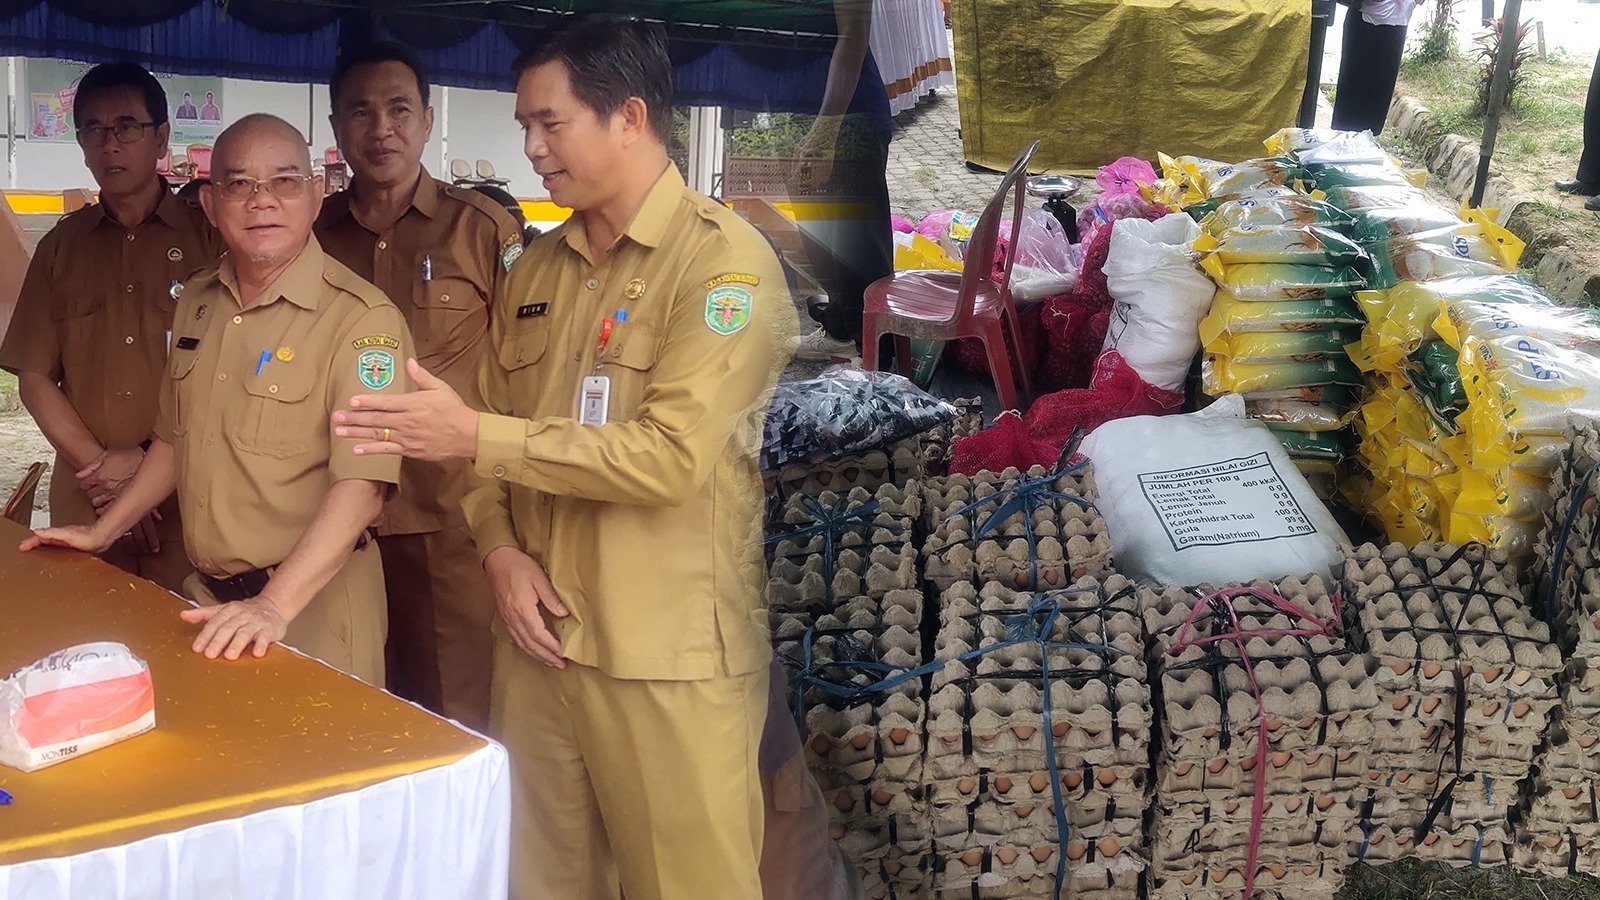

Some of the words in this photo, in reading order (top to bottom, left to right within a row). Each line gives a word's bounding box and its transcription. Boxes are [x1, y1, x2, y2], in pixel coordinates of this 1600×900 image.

[1153, 468, 1210, 480] INFORMASI
[1211, 462, 1238, 473] NILAI
[1239, 458, 1258, 468] GIZI
[1148, 481, 1191, 491] JUMLAH
[1192, 478, 1213, 487] PER
[1215, 475, 1231, 483] 100
[1151, 491, 1186, 500] Energi
[1187, 487, 1211, 496] Total
[1242, 480, 1259, 488] 400
[1258, 476, 1278, 486] kkal
[1156, 496, 1191, 504] Lemak
[1191, 493, 1216, 501] Total
[1160, 502, 1195, 512] Lemak
[1197, 499, 1227, 507] Jenuh
[1273, 492, 1280, 500] 0
[1164, 508, 1203, 520] Protein
[1169, 514, 1230, 528] Karbohidrat
[1229, 512, 1256, 521] Total
[1274, 508, 1291, 516] 100
[1174, 525, 1200, 536] Gula
[1179, 529, 1261, 545] Garam(Natrium)
[1287, 525, 1295, 533] 0
[1296, 524, 1311, 532] mg
